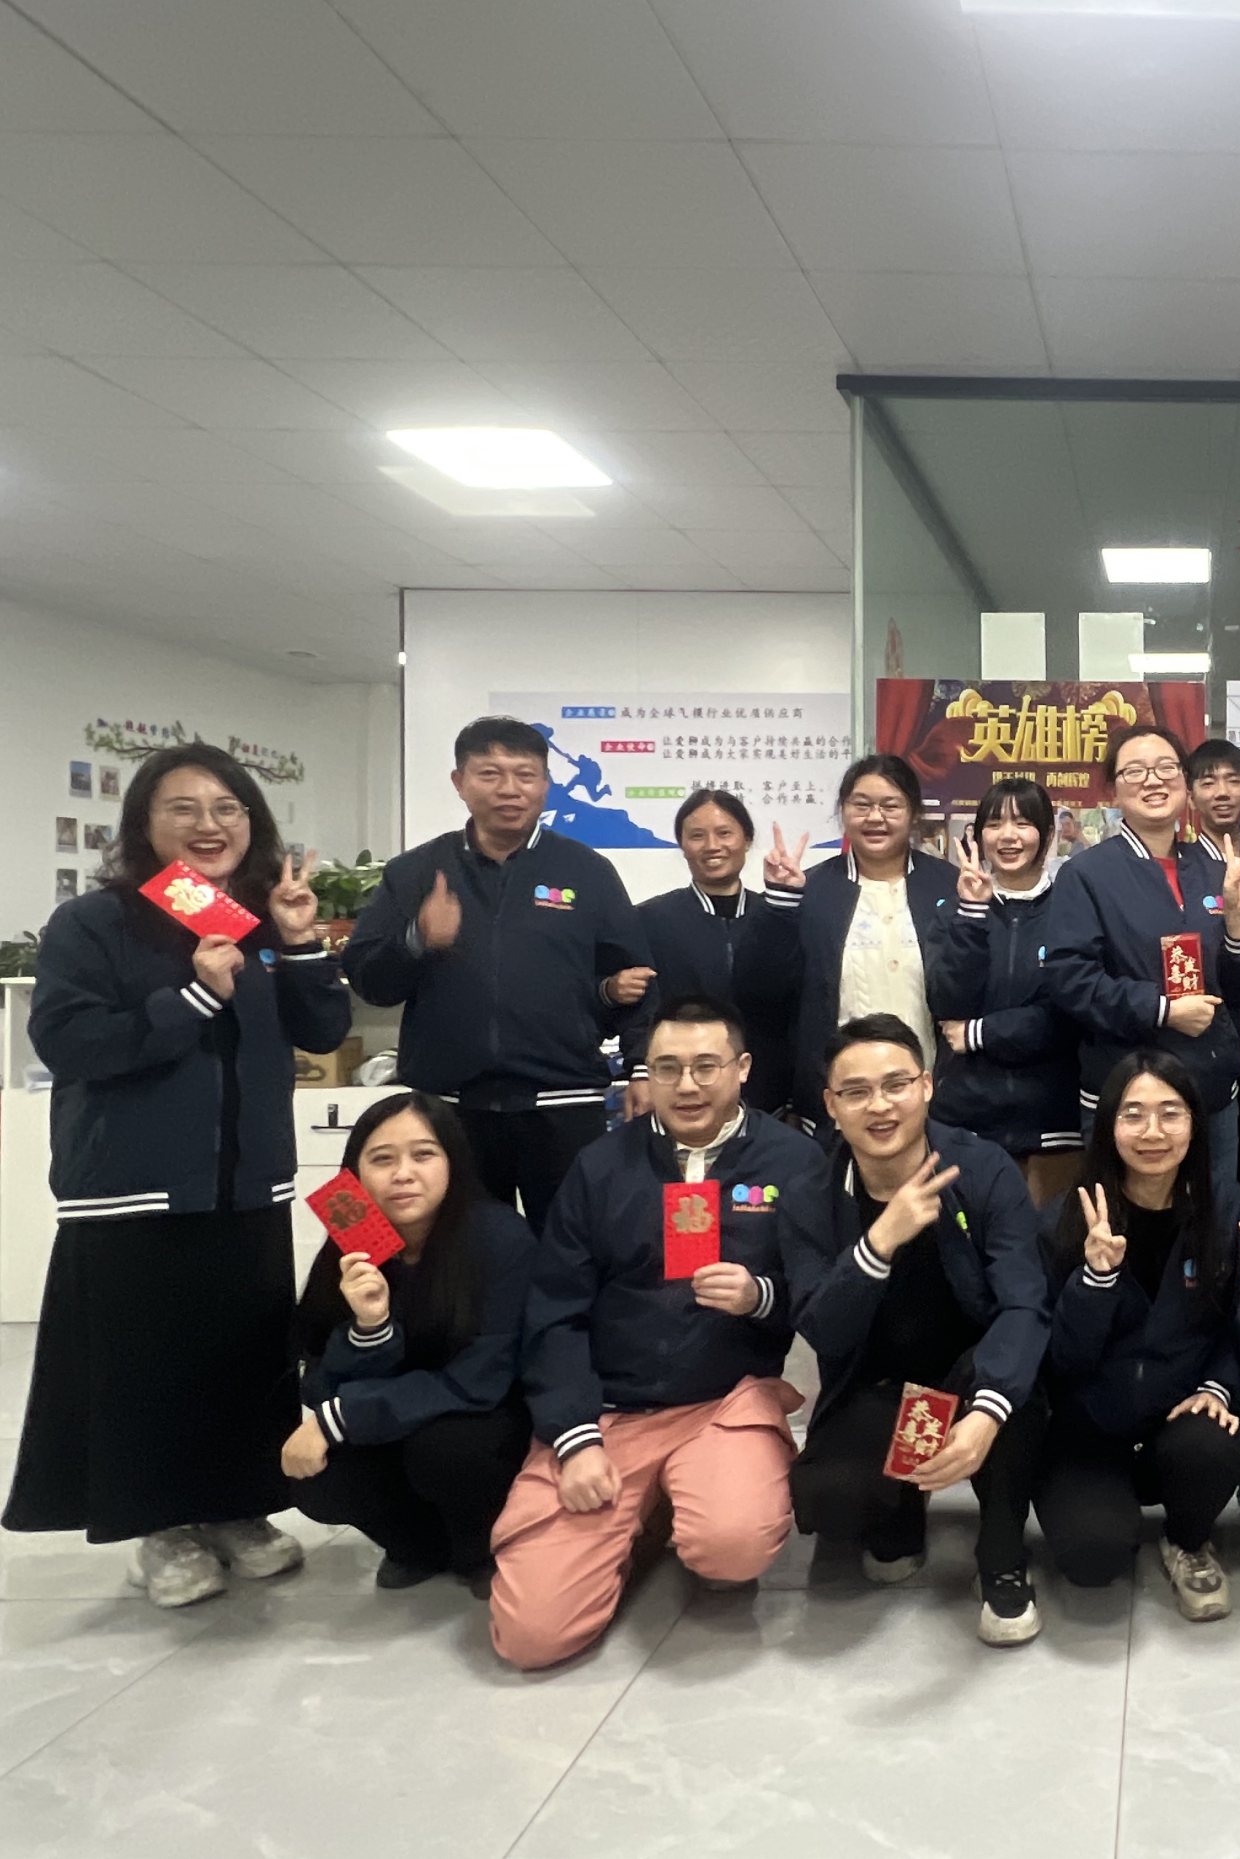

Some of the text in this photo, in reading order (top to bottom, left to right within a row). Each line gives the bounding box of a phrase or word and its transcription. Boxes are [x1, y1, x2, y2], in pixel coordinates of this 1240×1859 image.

[961, 694, 1108, 763] 英雄榜
[164, 878, 215, 915] 福
[327, 1190, 367, 1231] 福
[671, 1194, 714, 1234] 福
